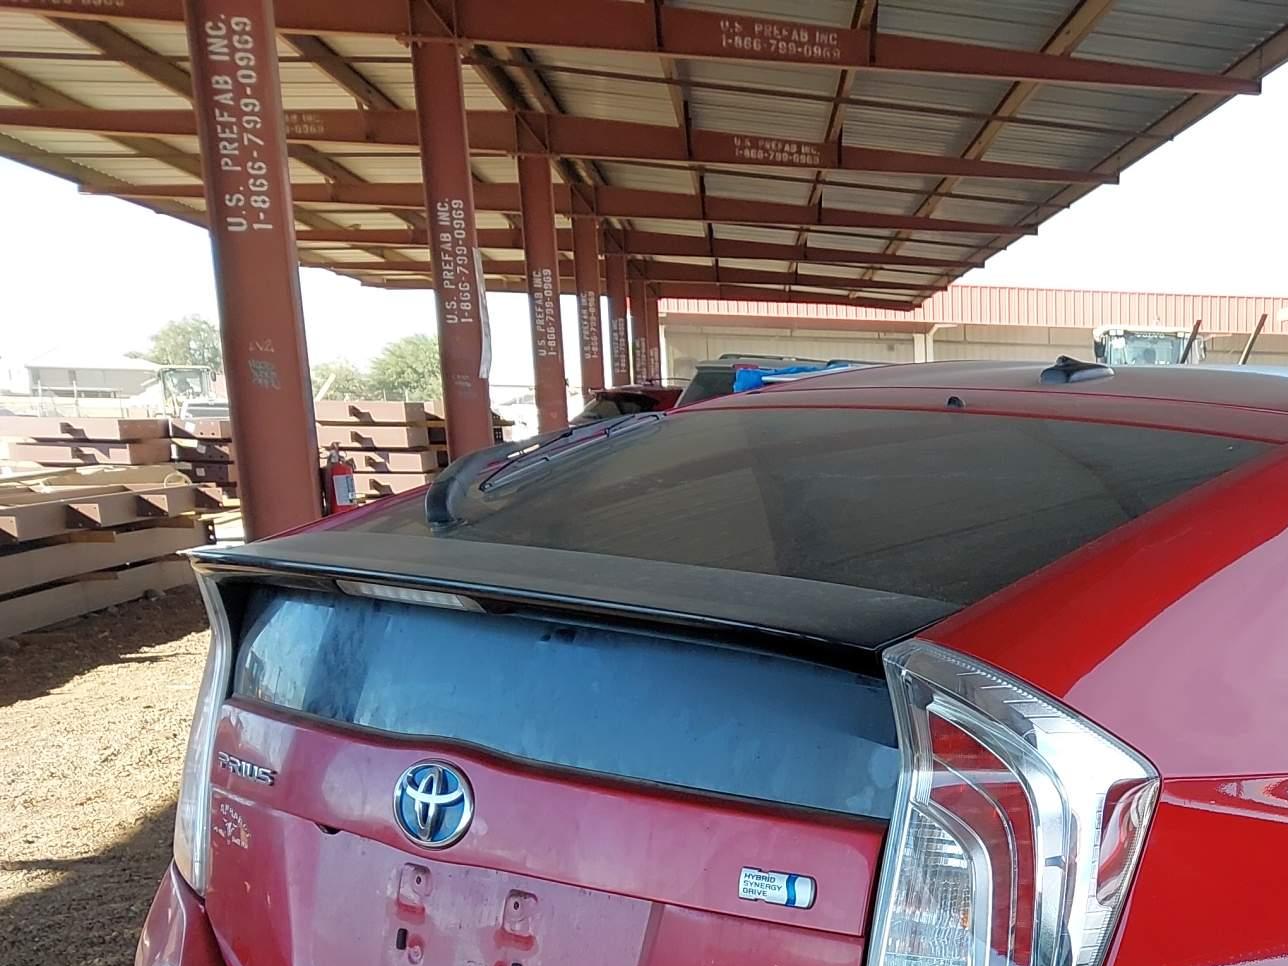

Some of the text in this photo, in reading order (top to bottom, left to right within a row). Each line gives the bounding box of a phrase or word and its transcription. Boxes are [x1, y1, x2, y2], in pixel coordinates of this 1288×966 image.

[754, 23, 809, 42] PREFAB
[204, 13, 249, 233] U.S. PREFAB INC.
[230, 15, 274, 231] 1-866-799-0969
[436, 198, 459, 324] U.S. PREFAB INC.
[451, 199, 473, 323] 1-866-799-0969
[218, 751, 278, 787] PRIUS
[742, 887, 768, 897] DRIVE
[743, 872, 776, 884] HYBRID
[743, 880, 783, 892] SYNERGY
